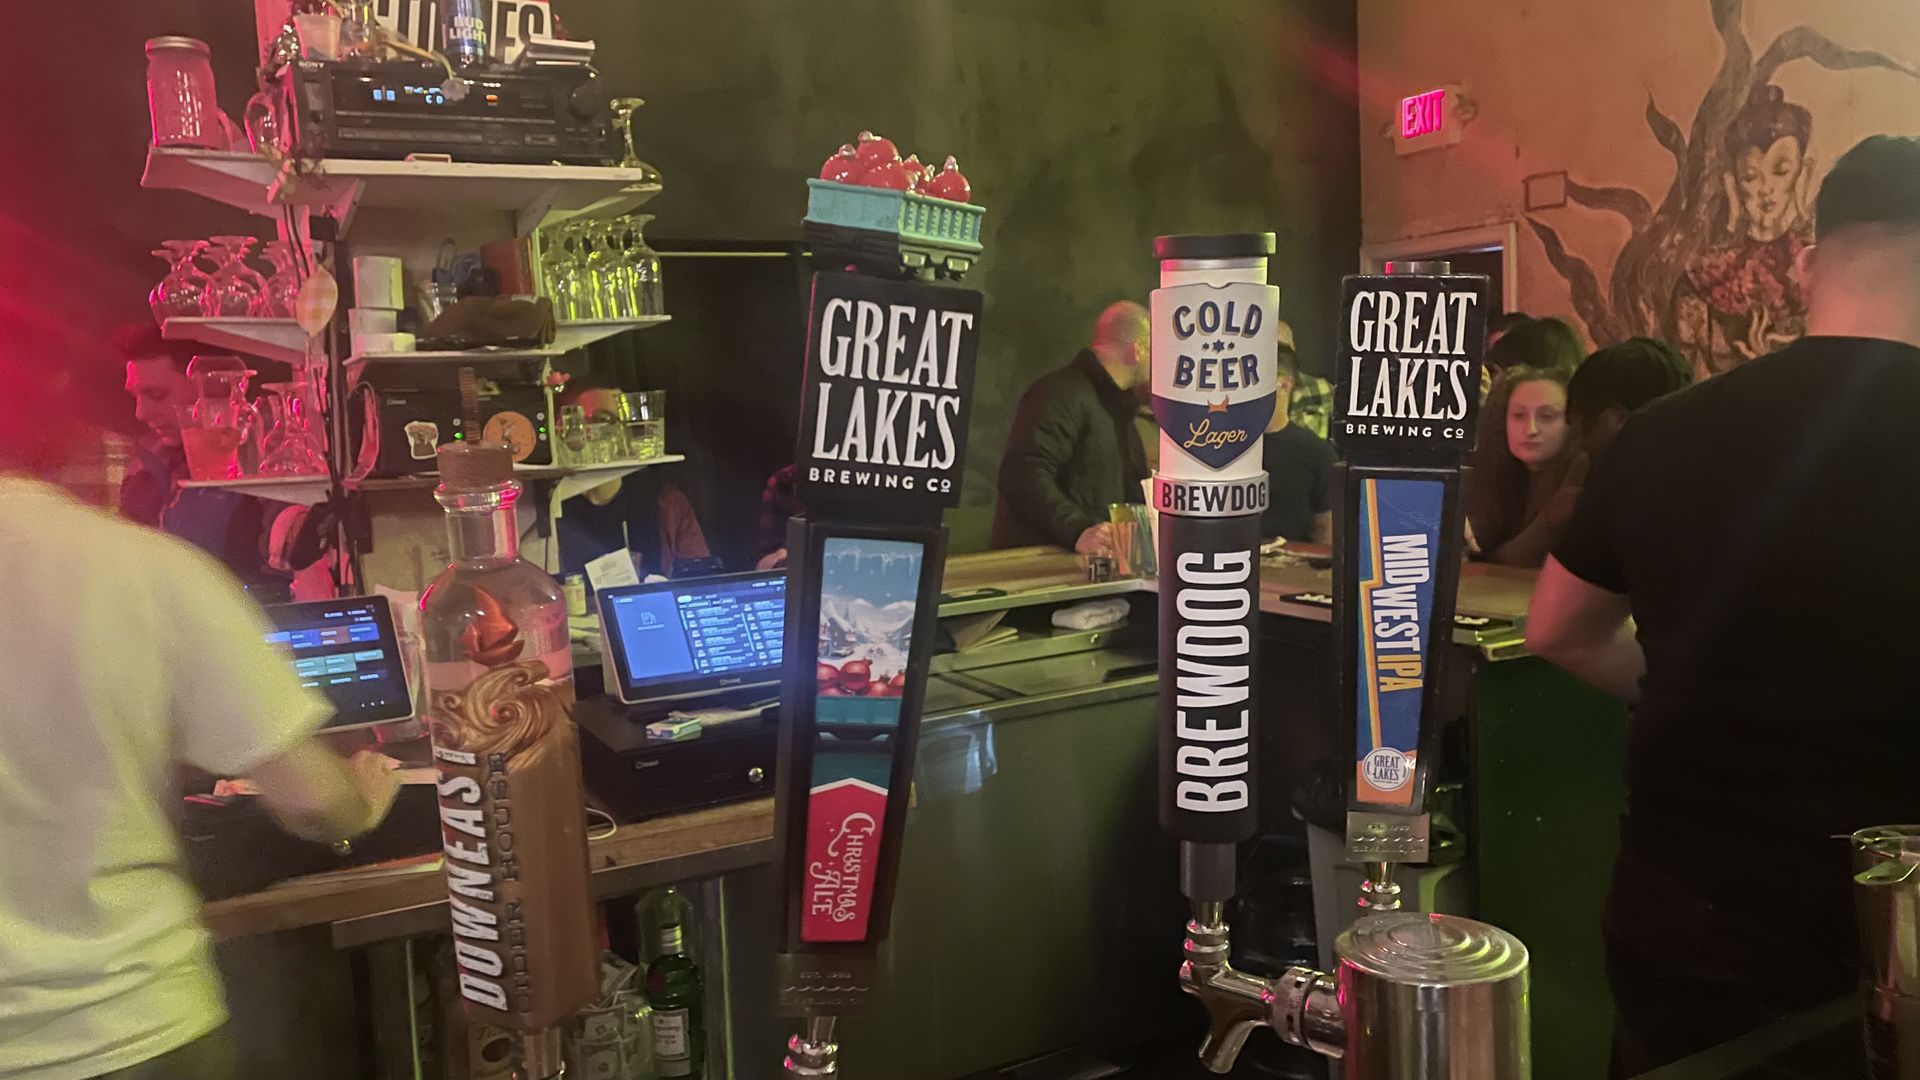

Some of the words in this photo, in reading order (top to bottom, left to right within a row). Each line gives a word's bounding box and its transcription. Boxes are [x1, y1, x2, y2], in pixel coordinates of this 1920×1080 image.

[450, 28, 487, 43] LIGHT
[1402, 88, 1445, 139] EXIT
[1172, 301, 1263, 340] COLD
[1350, 290, 1477, 355] GREAT
[819, 297, 973, 390] GREAT
[1173, 354, 1260, 392] BEER
[1347, 356, 1470, 421] LAKES
[812, 382, 960, 470] LAKES
[1184, 418, 1248, 450] Lager
[1346, 423, 1432, 438] BREWING
[809, 467, 914, 490] BREWING
[1162, 481, 1267, 512] BREWDOG
[1176, 550, 1251, 812] BREWDOG
[1377, 654, 1424, 693] IPA
[1372, 767, 1399, 781] LAKES
[1374, 754, 1401, 768] GREAT
[487, 753, 521, 883] HOUSE
